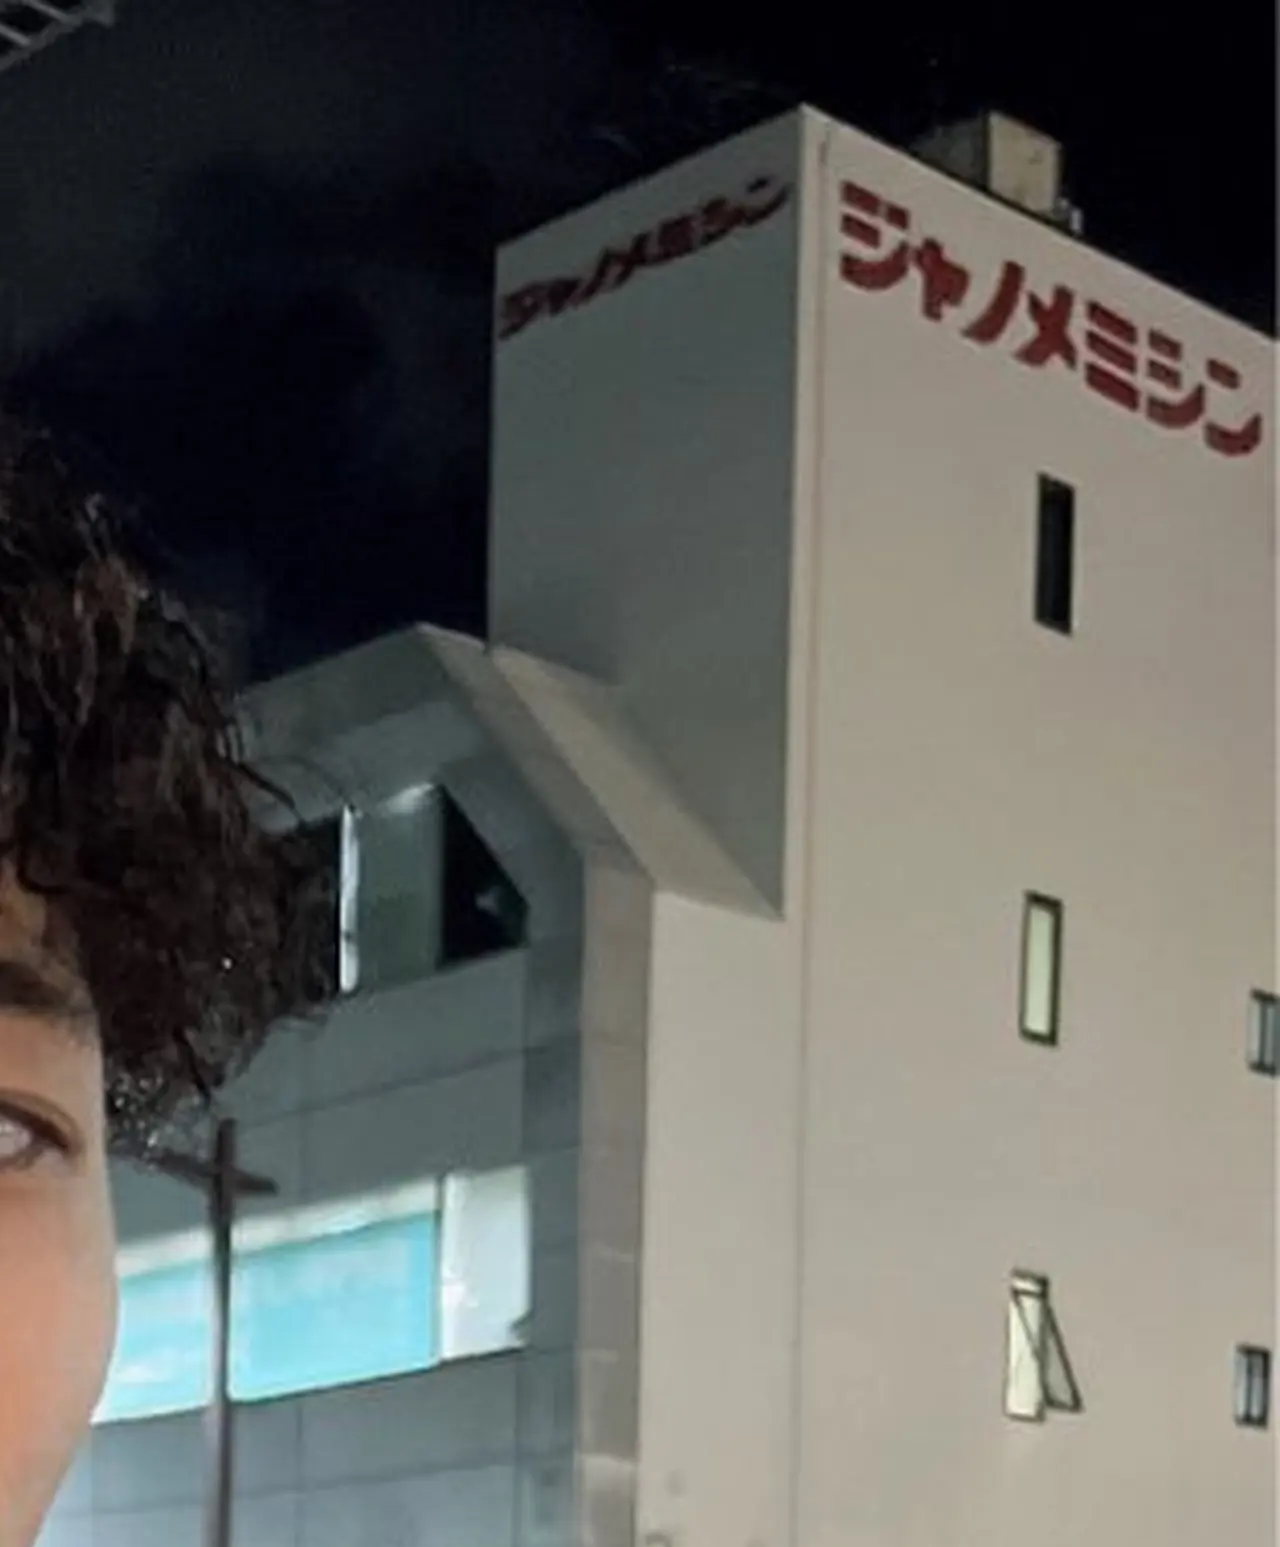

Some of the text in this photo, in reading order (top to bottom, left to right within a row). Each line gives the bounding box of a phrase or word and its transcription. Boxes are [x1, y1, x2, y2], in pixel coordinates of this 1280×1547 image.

[840, 180, 1262, 457] ジャノメミシン
